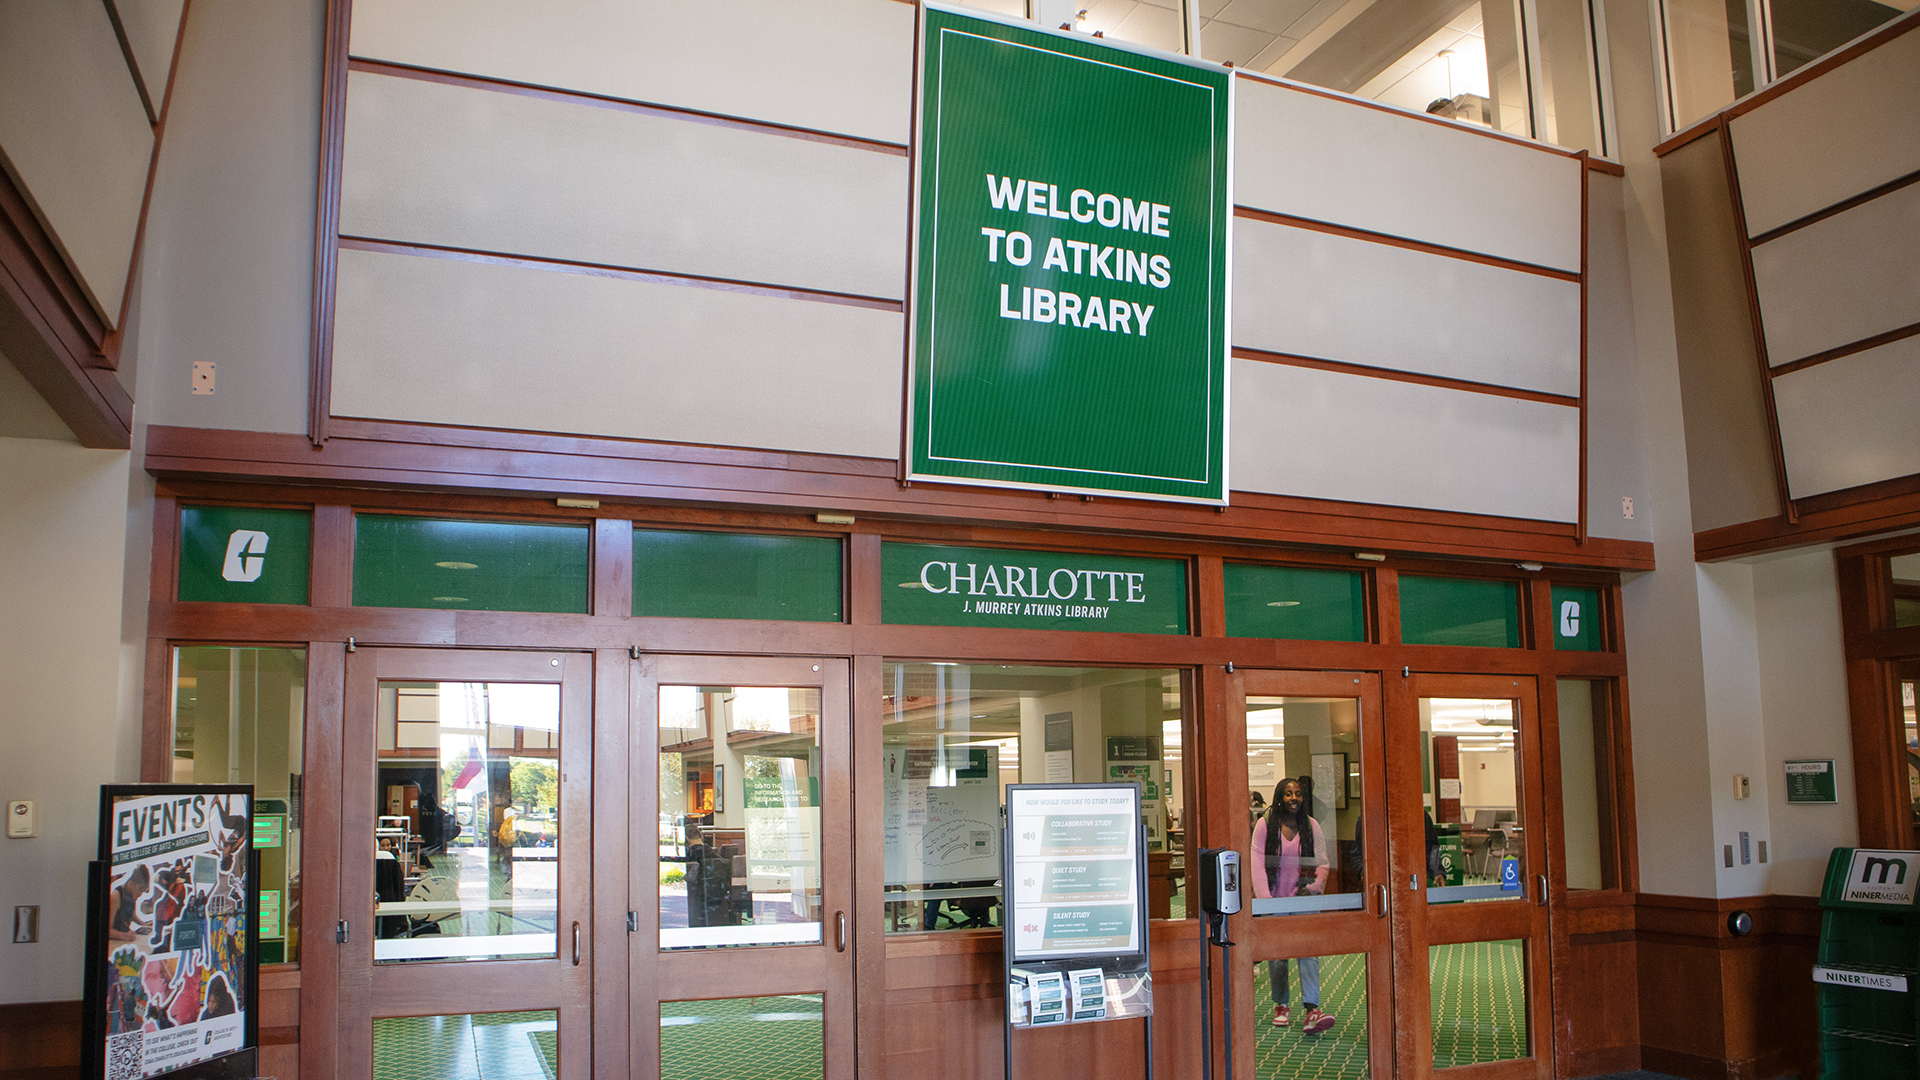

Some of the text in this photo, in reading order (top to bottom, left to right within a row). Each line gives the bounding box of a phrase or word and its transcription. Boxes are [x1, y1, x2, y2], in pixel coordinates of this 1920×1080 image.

[986, 173, 1171, 238] WELCOME
[981, 226, 1171, 289] TO ATKINS
[1000, 283, 1155, 337] LIBRARY
[920, 560, 1146, 603] CHARLOTTE
[963, 600, 1109, 618] J. MURREY ATKINS LIBRARY
[1113, 745, 1120, 756] 1
[116, 794, 206, 848] EVENTS
[1051, 820, 1094, 828] COLLABORATIVE
[120, 851, 130, 861] THE
[130, 846, 152, 859] COLLEGE
[151, 844, 158, 853] OF
[158, 841, 171, 852] ARTS
[175, 831, 208, 848] ARCHITECTURE
[1051, 866, 1087, 874] QUIET STUDY
[1861, 856, 1908, 885] m
[1851, 891, 1910, 901] NINERMEDIA
[1072, 911, 1091, 919] STUDY
[1826, 972, 1892, 988] NINERTIMES
[151, 1036, 160, 1044] SEE
[160, 1032, 176, 1042] WHAT'S
[176, 1027, 198, 1038] HAPPENING
[176, 1039, 190, 1048] CHECK
